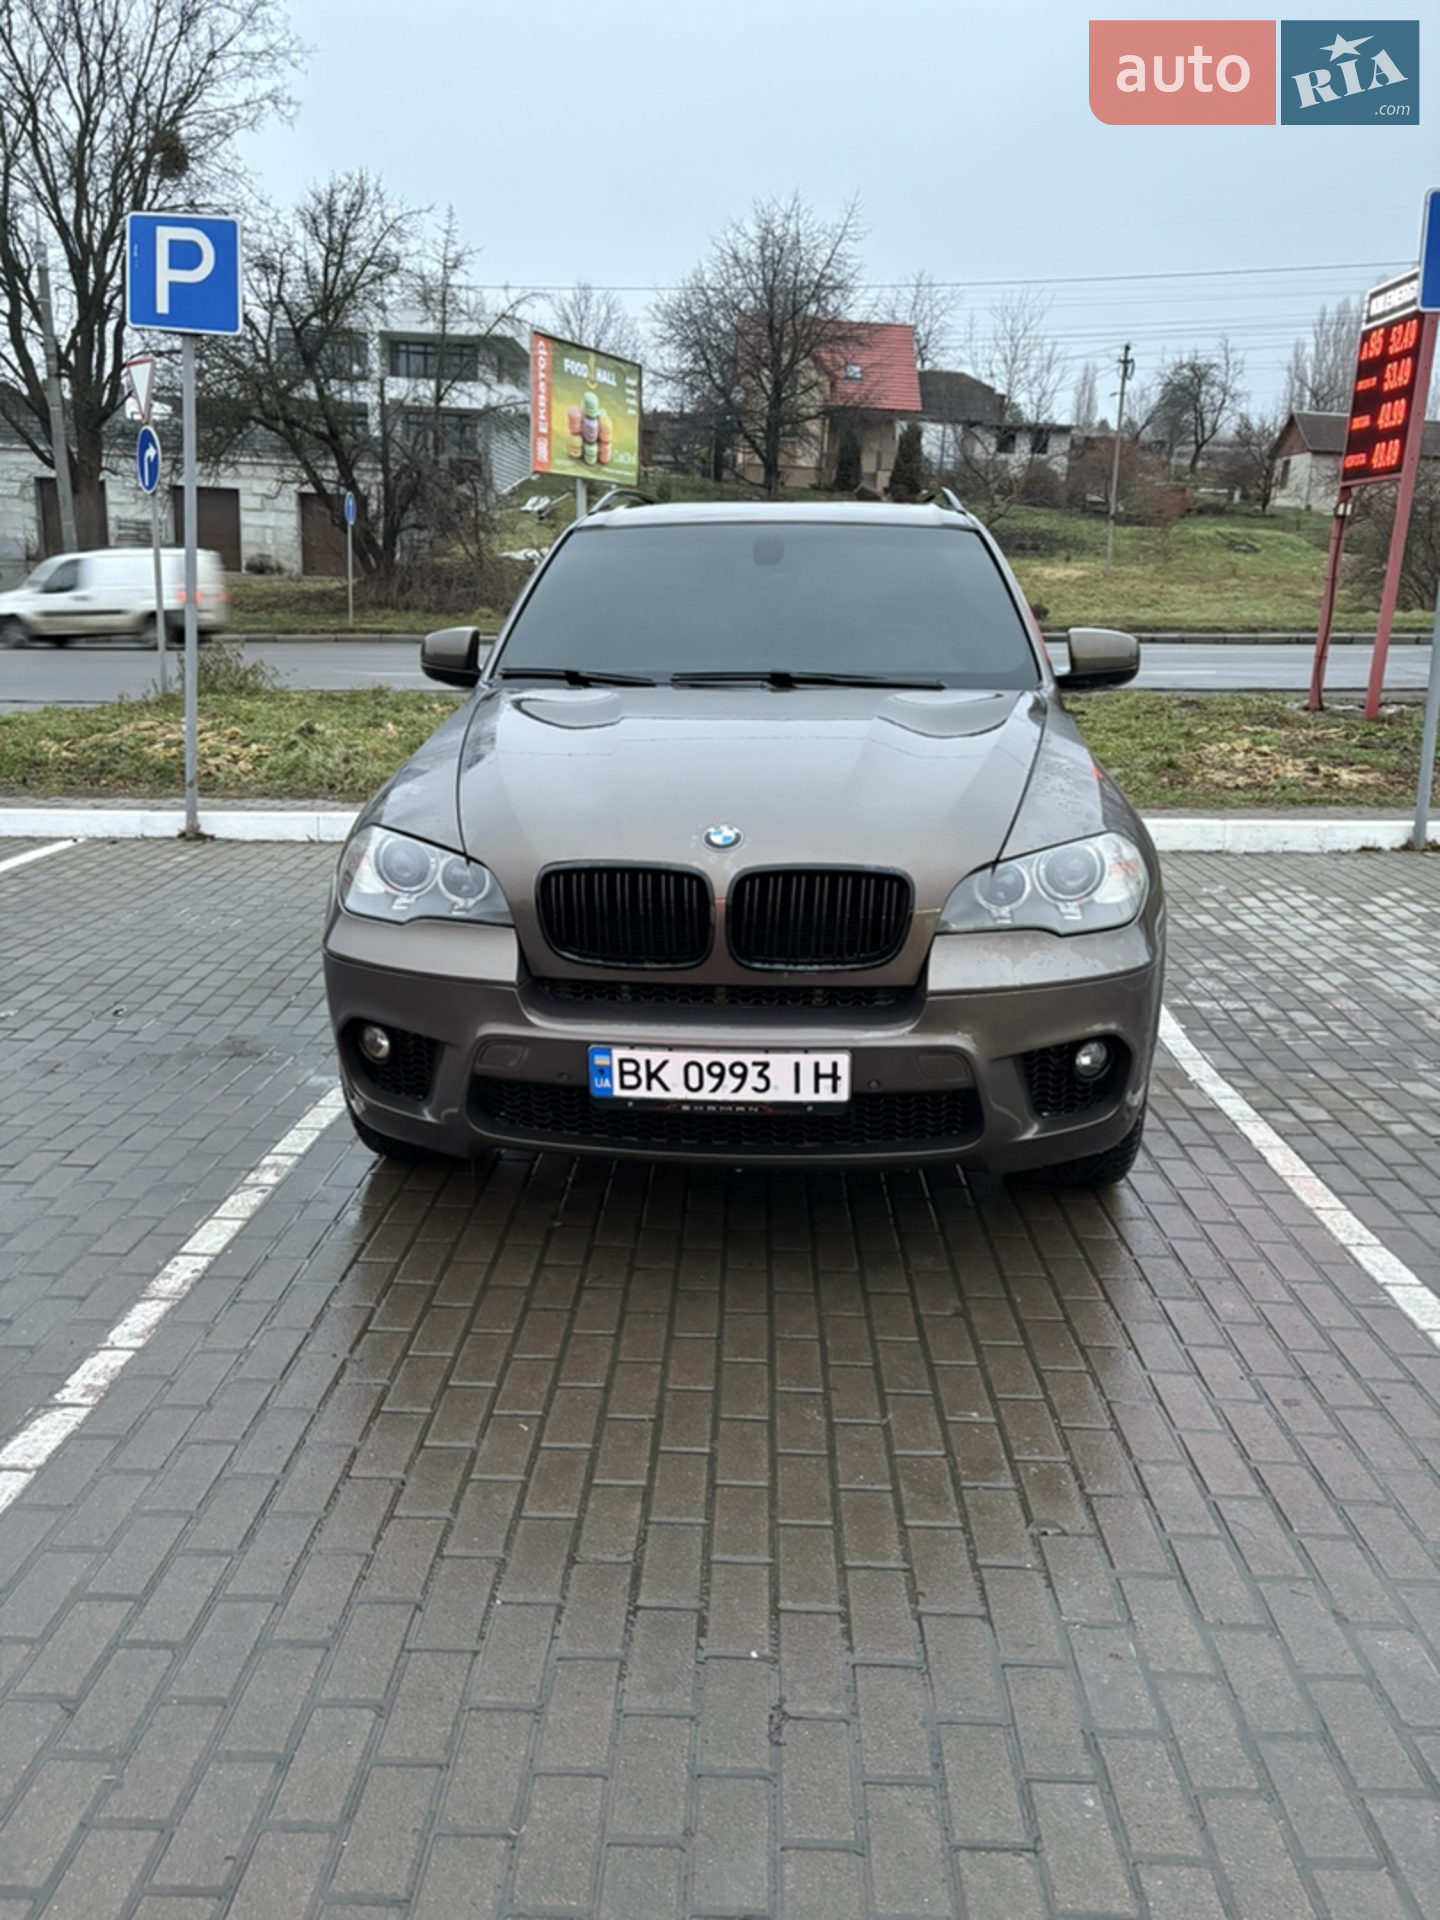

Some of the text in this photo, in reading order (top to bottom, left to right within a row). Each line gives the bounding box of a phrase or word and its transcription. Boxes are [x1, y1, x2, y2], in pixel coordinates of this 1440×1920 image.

[156, 225, 216, 315] P
[563, 357, 588, 378] FOOD
[594, 1077, 612, 1089] UA
[617, 1057, 671, 1092] BK
[683, 1060, 771, 1094] 0993
